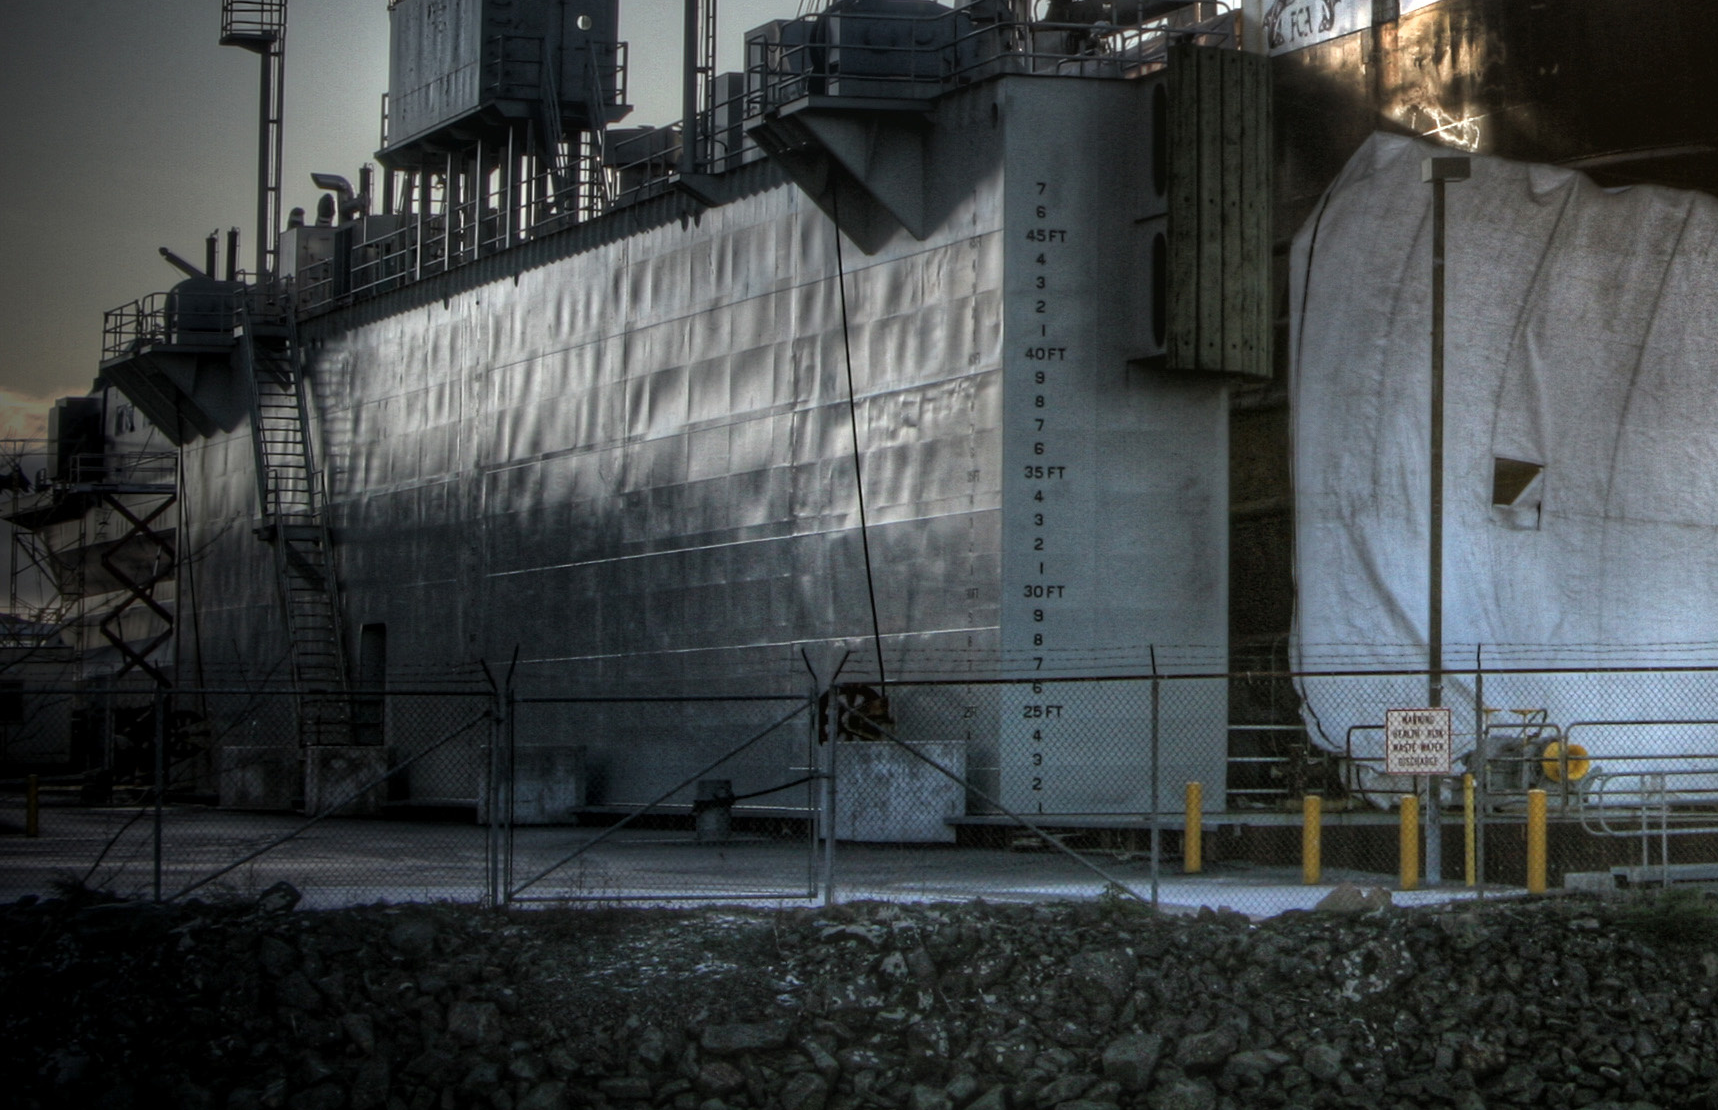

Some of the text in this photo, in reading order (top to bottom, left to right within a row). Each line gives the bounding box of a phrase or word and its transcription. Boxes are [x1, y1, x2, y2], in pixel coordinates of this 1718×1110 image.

[1036, 182, 1047, 195] 7
[1036, 205, 1046, 218] 6
[1036, 253, 1046, 265] 4
[1036, 276, 1046, 289] 3
[1036, 301, 1046, 313] 2
[1035, 371, 1045, 384] 9
[1035, 395, 1045, 408] 8
[1035, 419, 1044, 431] 7
[1034, 442, 1044, 455] 6
[1034, 490, 1044, 503] 4
[1034, 514, 1044, 526] 3
[1034, 538, 1044, 551] 2
[1034, 609, 1044, 622] 9
[1034, 633, 1043, 646] 8
[1034, 658, 1043, 670] 7
[1033, 730, 1043, 742] 4
[1033, 754, 1042, 766] 3
[1032, 778, 1042, 791] 2
